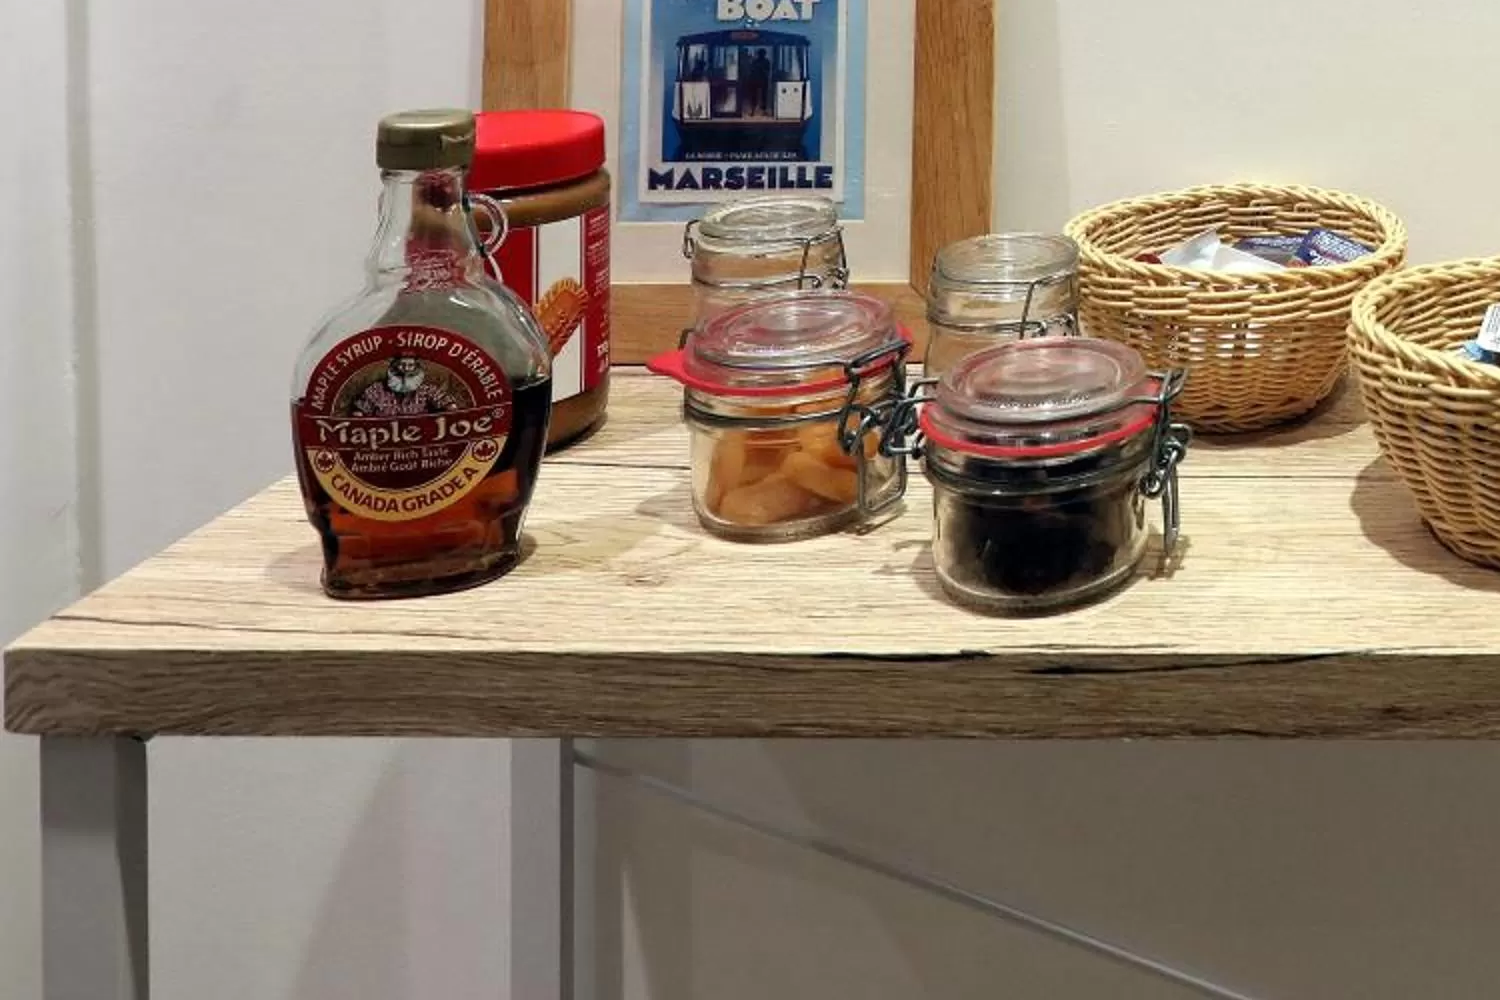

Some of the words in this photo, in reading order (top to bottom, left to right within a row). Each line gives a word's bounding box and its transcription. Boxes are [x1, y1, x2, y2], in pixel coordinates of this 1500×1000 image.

[647, 165, 834, 191] MARSEILLE
[310, 363, 342, 411] MAPLE
[336, 334, 384, 367] SYRUP
[396, 331, 449, 351] SIROP
[447, 344, 505, 400] D'ÉRABLE
[315, 418, 423, 450] Maple
[431, 414, 494, 441] Joe
[351, 461, 389, 474] Ambré
[420, 457, 453, 470] Riche
[352, 450, 391, 462] Amber
[392, 448, 419, 461] Rich
[330, 472, 401, 514] CANADA
[401, 479, 467, 512] GRADE
[462, 467, 480, 482] A
